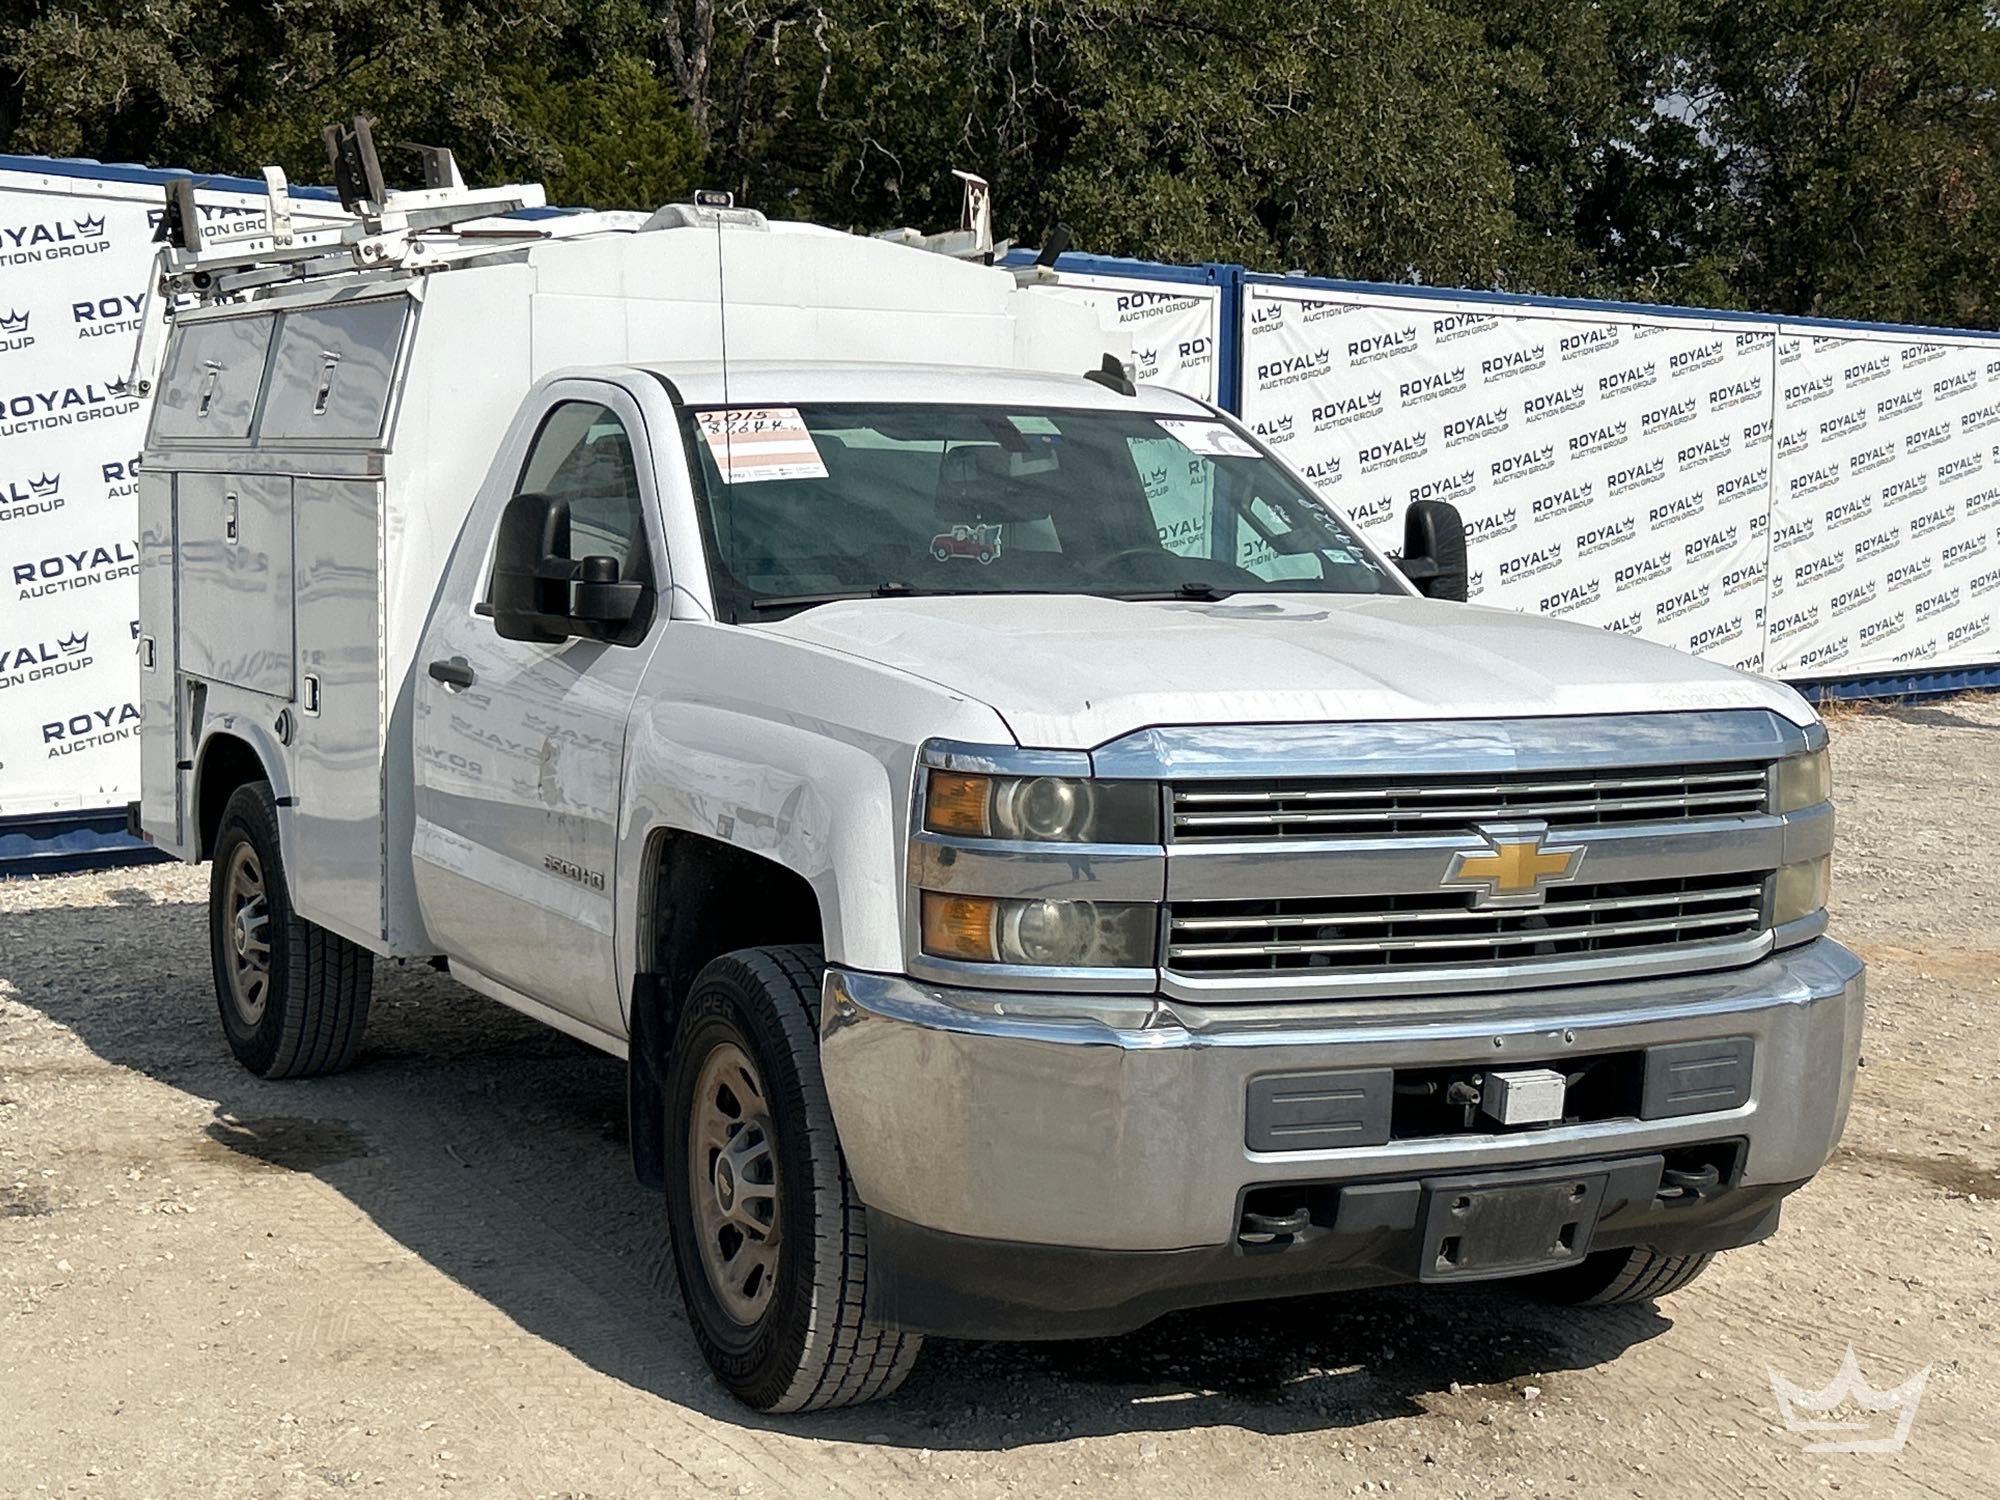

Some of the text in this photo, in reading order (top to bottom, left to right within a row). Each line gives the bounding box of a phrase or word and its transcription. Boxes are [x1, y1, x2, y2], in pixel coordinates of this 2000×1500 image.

[0, 222, 75, 249] YAL
[0, 241, 110, 266] TION GROUP
[72, 293, 145, 322] ROY
[1119, 307, 1163, 323] AUCTION
[1303, 307, 1341, 323] AUCTION
[1252, 321, 1284, 335] GROUP
[1435, 328, 1472, 344] AUCTION
[1348, 330, 1404, 356] ROYAL
[1560, 329, 1607, 352] ROYAL
[1258, 353, 1316, 380] ROYAL
[1350, 350, 1390, 368] AUCTION
[1482, 350, 1531, 374] ROYAL
[1670, 345, 1713, 368] ROYAL
[1484, 368, 1518, 384] AUCTION
[1599, 366, 1645, 390] ROYAL
[1845, 359, 1882, 380] ROYAL
[1260, 374, 1302, 392] AUCTION
[1400, 372, 1454, 398] ROYAL
[1709, 380, 1751, 404] ROYAL
[1785, 378, 1824, 401] ROYAL
[1934, 373, 1968, 394] ROYAL
[1312, 395, 1369, 422] ROYAL
[1402, 390, 1440, 408] AUCTION
[1524, 388, 1573, 414] ROYAL
[1878, 392, 1914, 414] ROYAL
[0, 402, 140, 436] UCTION GROUP
[700, 411, 768, 423] 2015
[1314, 415, 1354, 433] AUCTION
[1444, 411, 1495, 438] ROYAL
[1642, 402, 1686, 426] ROYAL
[1820, 412, 1859, 434] ROYAL
[1961, 406, 1995, 426] ROYAL
[1269, 432, 1295, 445] ROUP
[1445, 431, 1482, 448] AUCTION
[1569, 425, 1616, 450] ROYAL
[1778, 434, 1798, 449] YAL
[1906, 425, 1942, 447] ROYAL
[1359, 436, 1413, 464] ROYAL
[1678, 438, 1721, 463] ROYAL
[1850, 446, 1888, 468] ROYAL
[1360, 457, 1400, 475] AUCTION
[1492, 450, 1541, 476] ROYAL
[1608, 462, 1653, 488] ROYAL
[1938, 457, 1973, 478] ROYAL
[1410, 474, 1462, 504] ROYAL
[1493, 469, 1528, 486] AUCTION
[1716, 472, 1758, 496] ROYAL
[1791, 467, 1830, 491] ROYAL
[1882, 477, 1919, 499] ROYAL
[1347, 502, 1378, 521] YAL
[1532, 487, 1580, 514] ROYAL
[1650, 496, 1693, 522] ROYAL
[1826, 499, 1864, 522] ROYAL
[1364, 513, 1393, 528] GROUP
[1464, 512, 1503, 537] OYAL
[1910, 510, 1946, 531] ROYAL
[1577, 521, 1623, 548] ROYAL
[1685, 530, 1727, 556] ROYAL
[1774, 523, 1803, 543] OYAL
[1855, 532, 1892, 554] ROYAL
[1942, 539, 1977, 560] ROYAL
[13, 543, 134, 585] ROYAL
[1500, 550, 1548, 576] ROYAL
[1615, 558, 1659, 583] ROYAL
[1722, 562, 1764, 588] ROYAL
[1795, 556, 1834, 579] ROYAL
[1887, 561, 1922, 584] ROYAL
[19, 573, 101, 601] AUCTION
[1540, 585, 1587, 612] ROYAL
[1831, 584, 1869, 609] ROYAL
[1656, 588, 1700, 615] ROYAL
[1916, 592, 1950, 614] ROYAL
[1603, 618, 1629, 631] YAL
[1690, 620, 1732, 648] ROYAL
[1770, 610, 1810, 635] ROYAL
[1860, 616, 1897, 640] ROYAL
[1948, 620, 1981, 642] ROYAL
[1801, 641, 1840, 666] ROYAL
[29, 657, 94, 681] GROUP
[42, 703, 141, 743] ROYA
[48, 728, 129, 759] AUCTION
